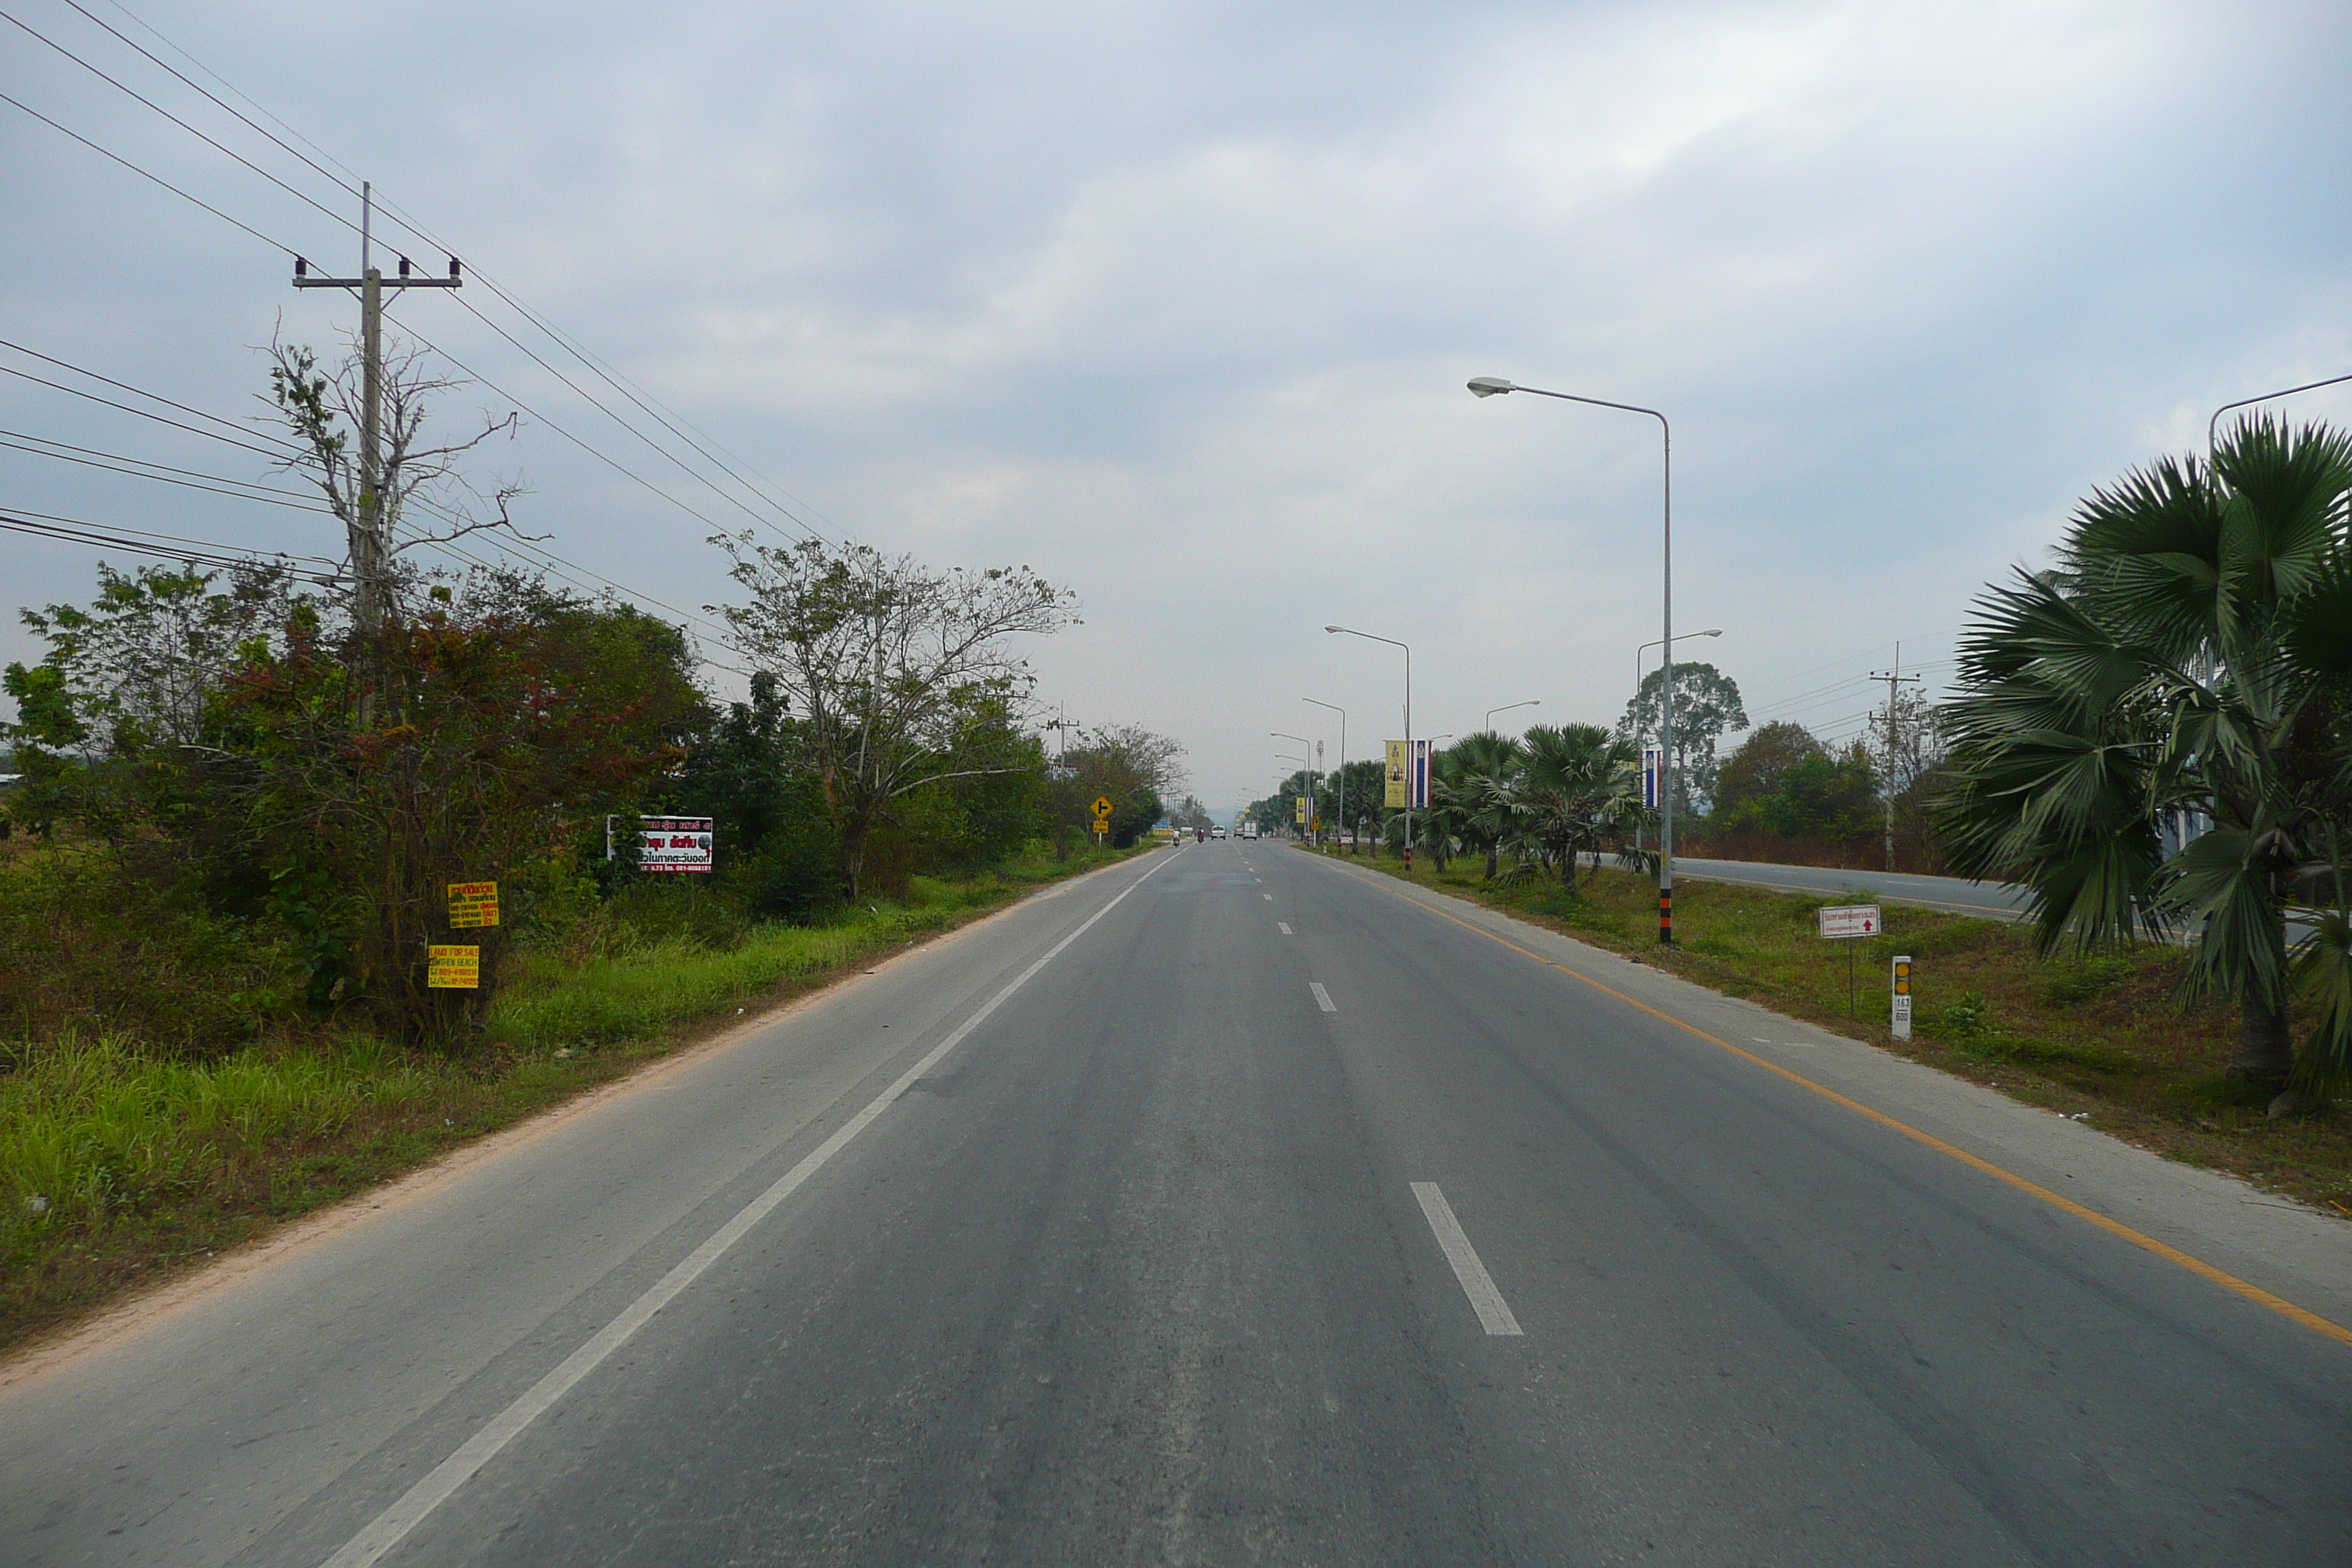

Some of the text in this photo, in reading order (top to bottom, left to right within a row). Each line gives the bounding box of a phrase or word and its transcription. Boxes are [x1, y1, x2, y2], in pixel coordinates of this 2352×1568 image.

[430, 948, 446, 956] LAND
[457, 958, 478, 966] BEACH
[1898, 998, 1909, 1007] 163
